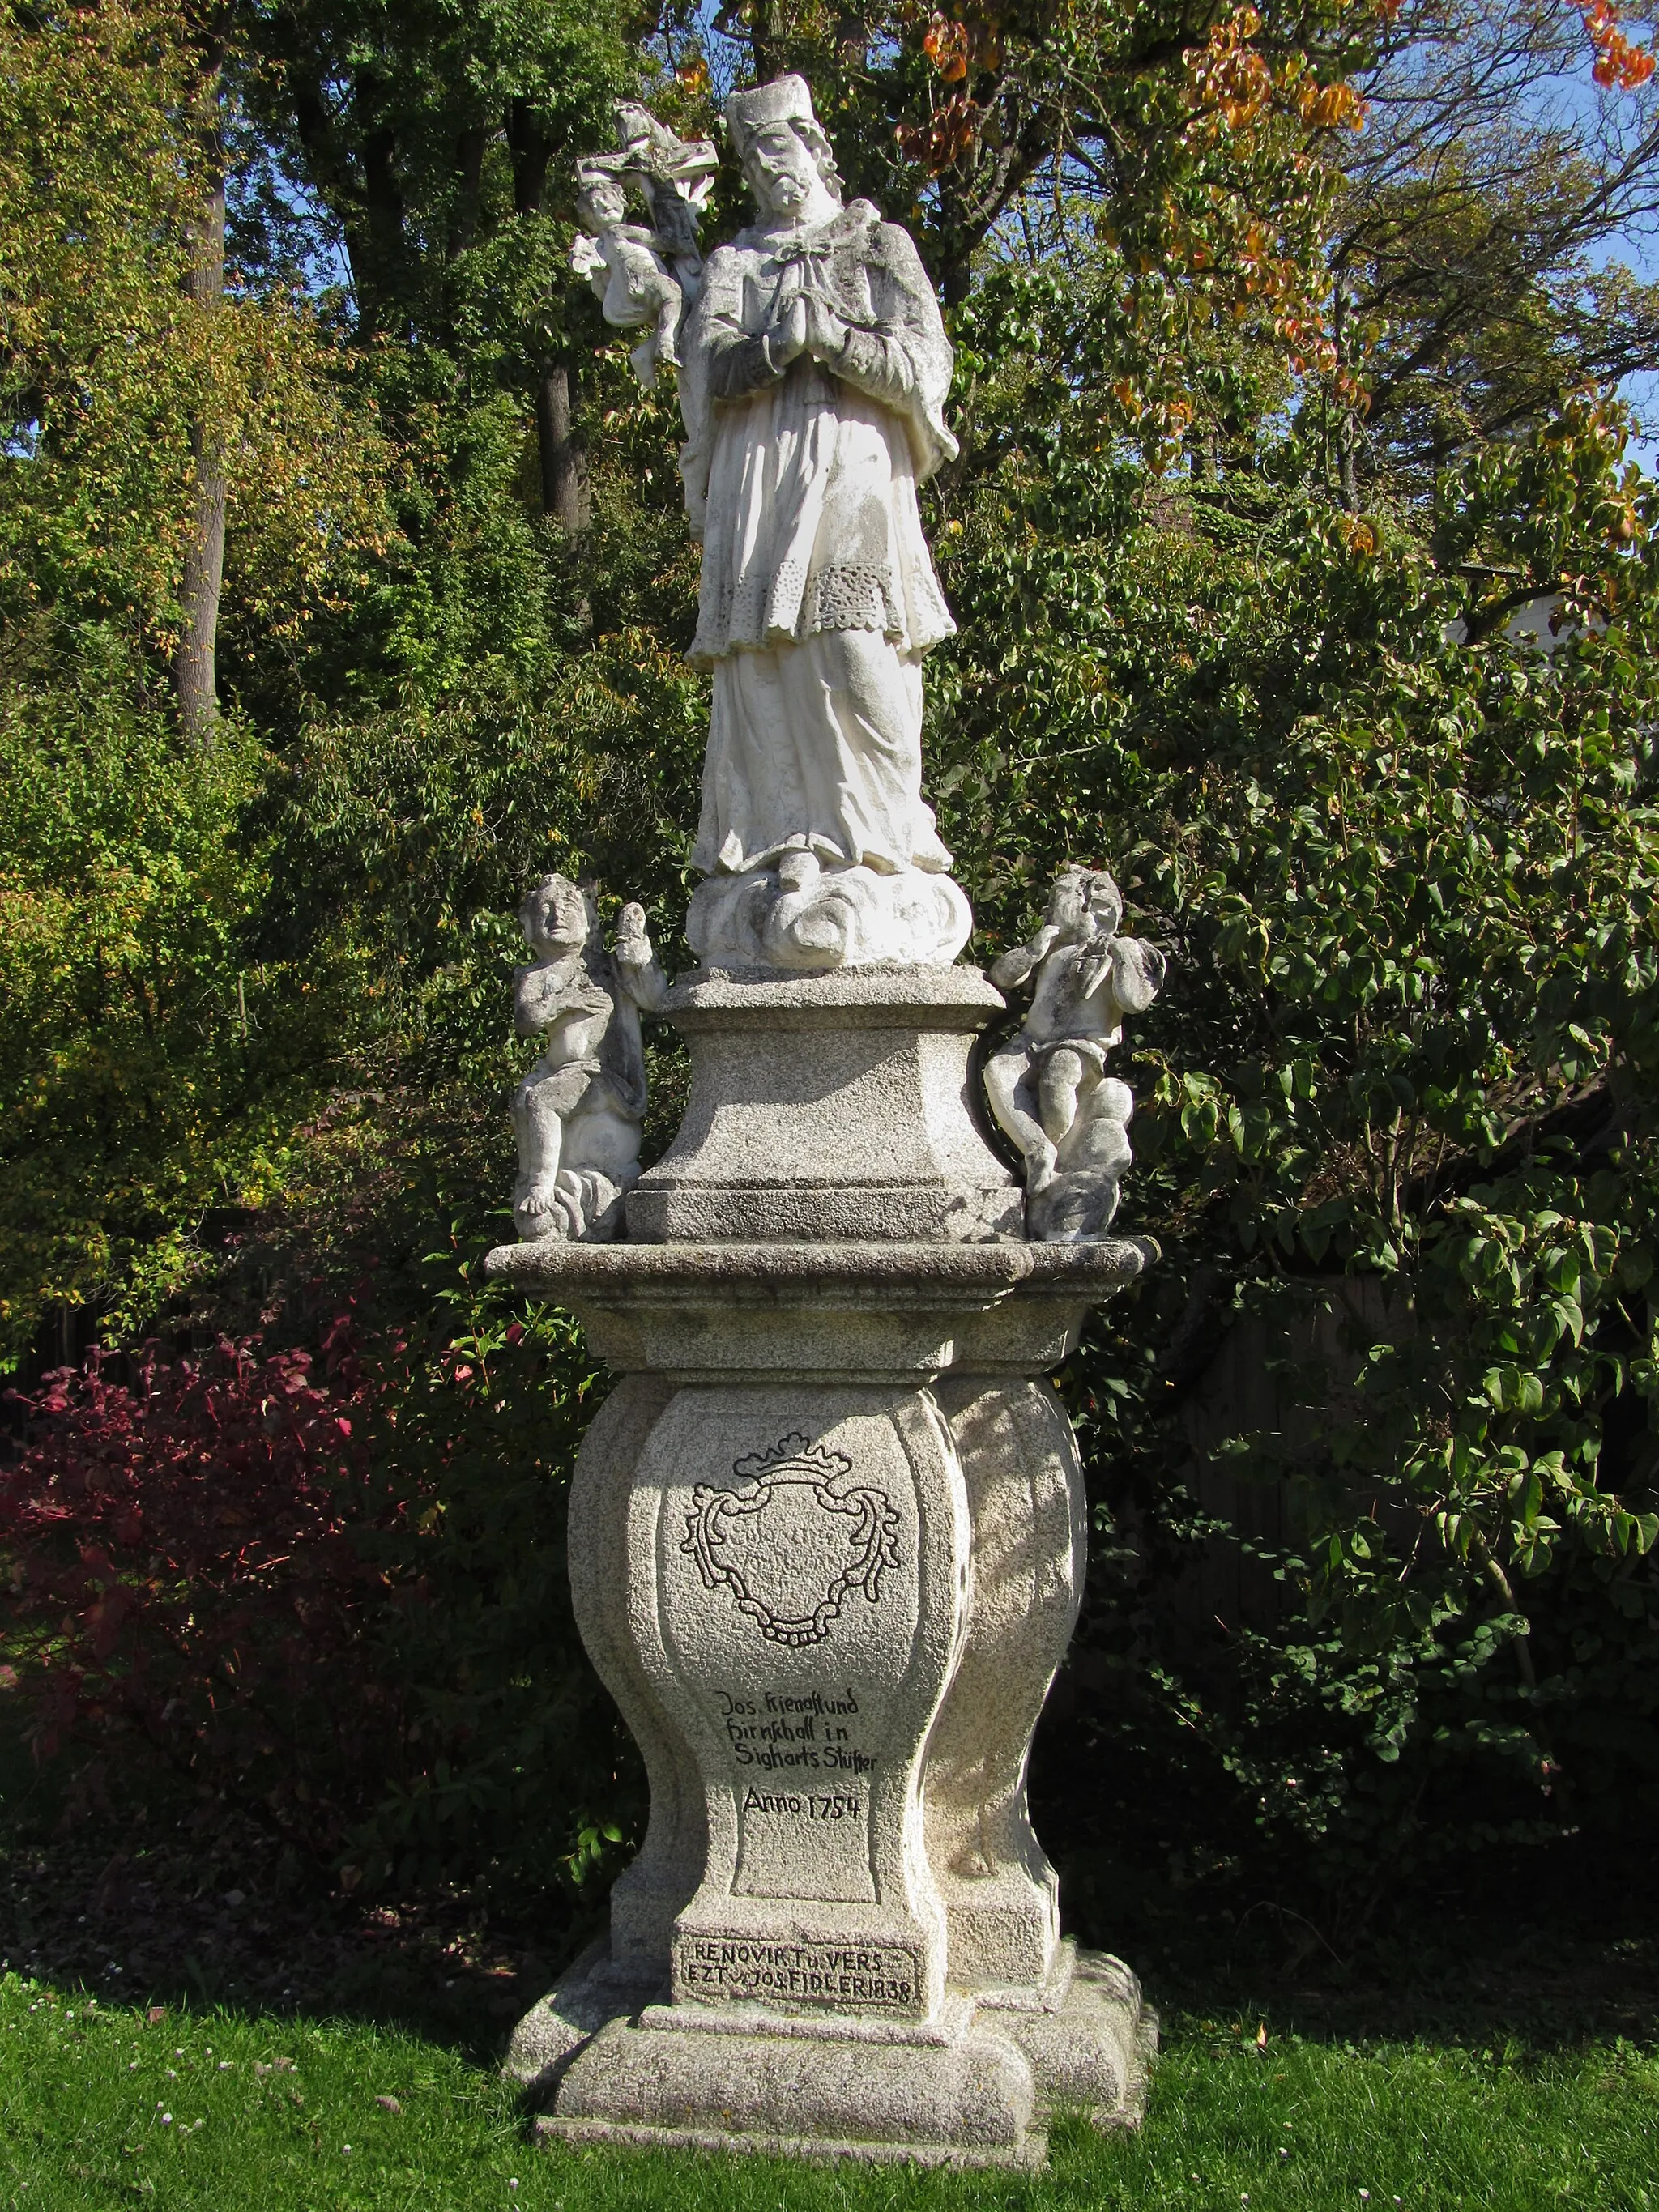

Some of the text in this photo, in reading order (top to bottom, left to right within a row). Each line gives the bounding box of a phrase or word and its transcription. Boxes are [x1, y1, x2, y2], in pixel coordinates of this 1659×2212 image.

[825, 1721, 849, 1741] in
[743, 1786, 862, 1820] Anno 1754
